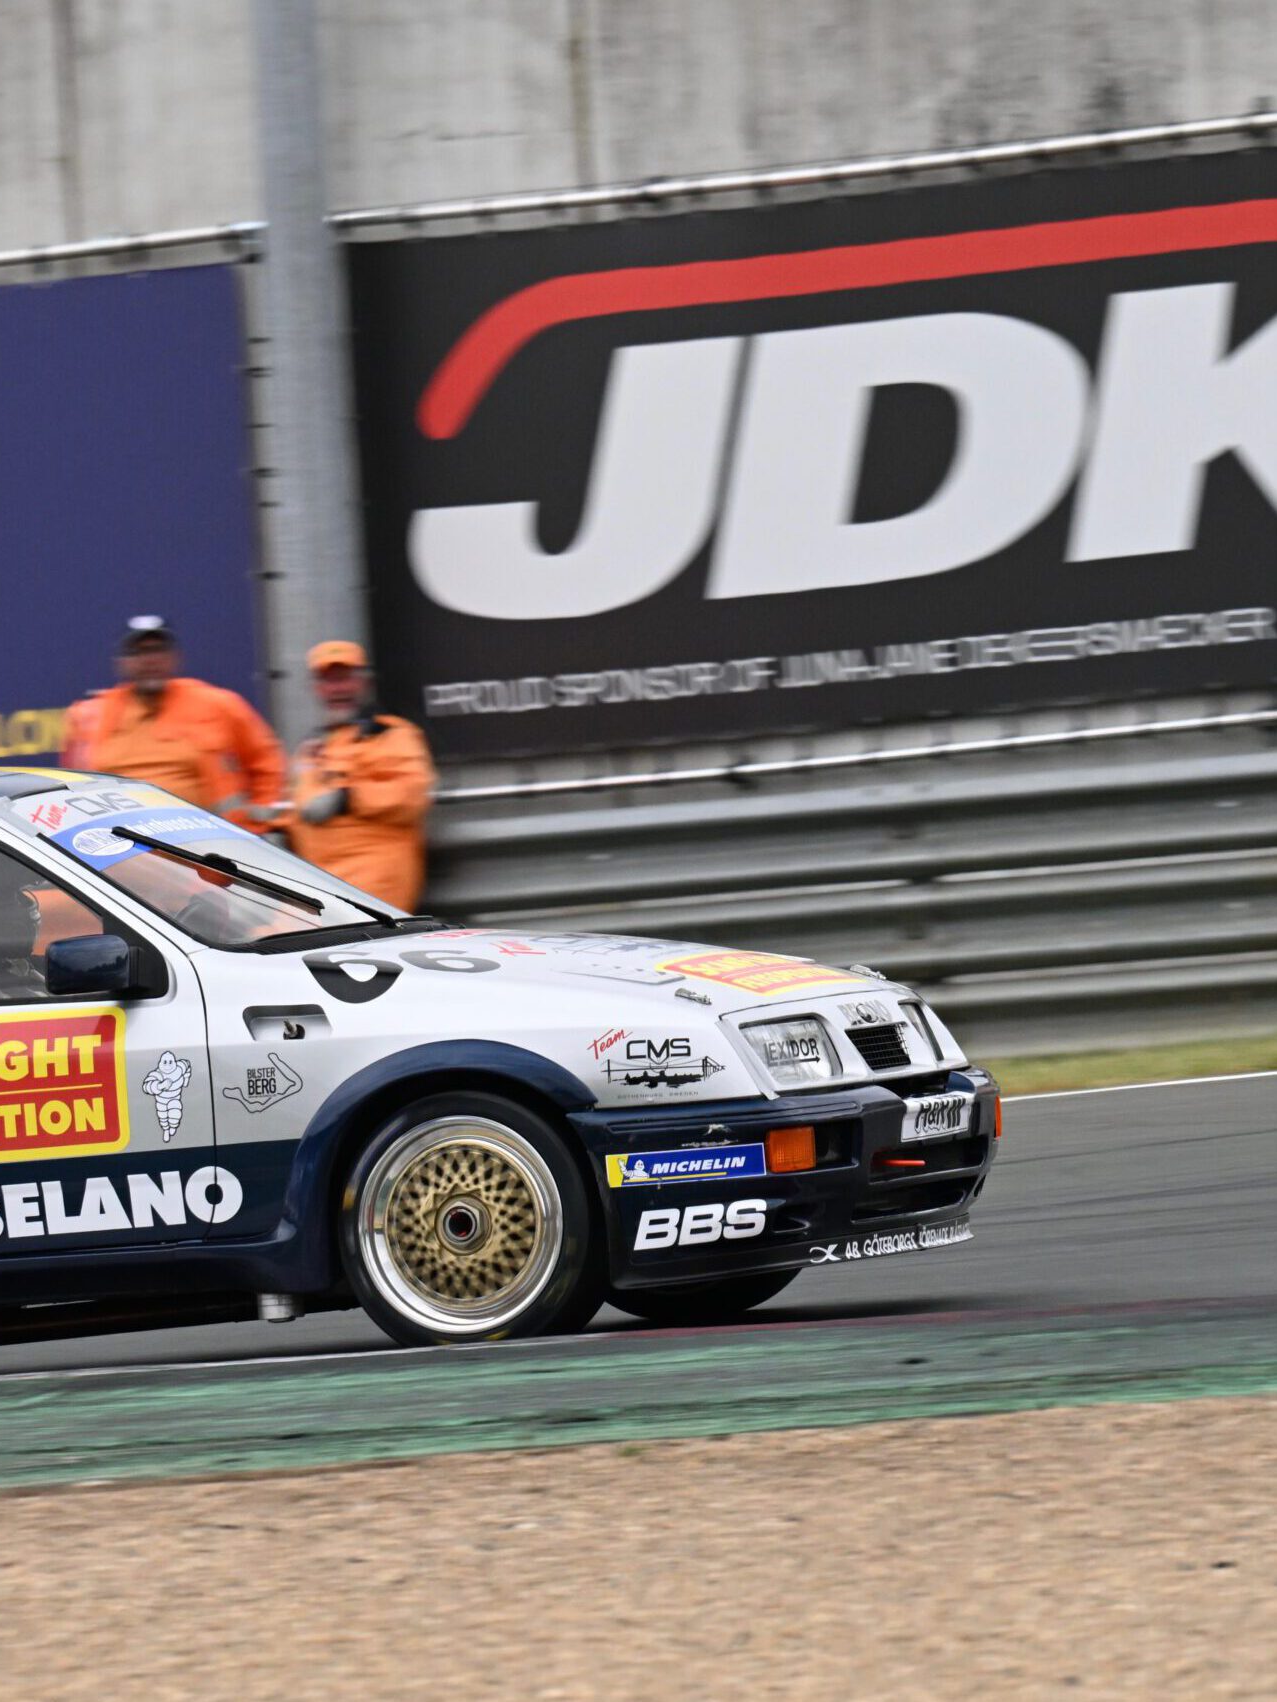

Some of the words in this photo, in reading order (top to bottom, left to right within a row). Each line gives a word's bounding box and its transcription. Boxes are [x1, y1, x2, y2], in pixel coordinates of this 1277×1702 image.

[407, 281, 1277, 619] JDK
[424, 675, 554, 717] PROUD
[553, 660, 723, 707] SPONSOR
[721, 655, 778, 693] OF
[588, 1028, 633, 1061] Team
[625, 1037, 692, 1060] CMS
[246, 1067, 276, 1079] BILSTER
[247, 1078, 277, 1096] BERG
[651, 1155, 747, 1176] MICHELIN
[632, 1198, 768, 1252] BBS
[845, 1240, 863, 1260] AB
